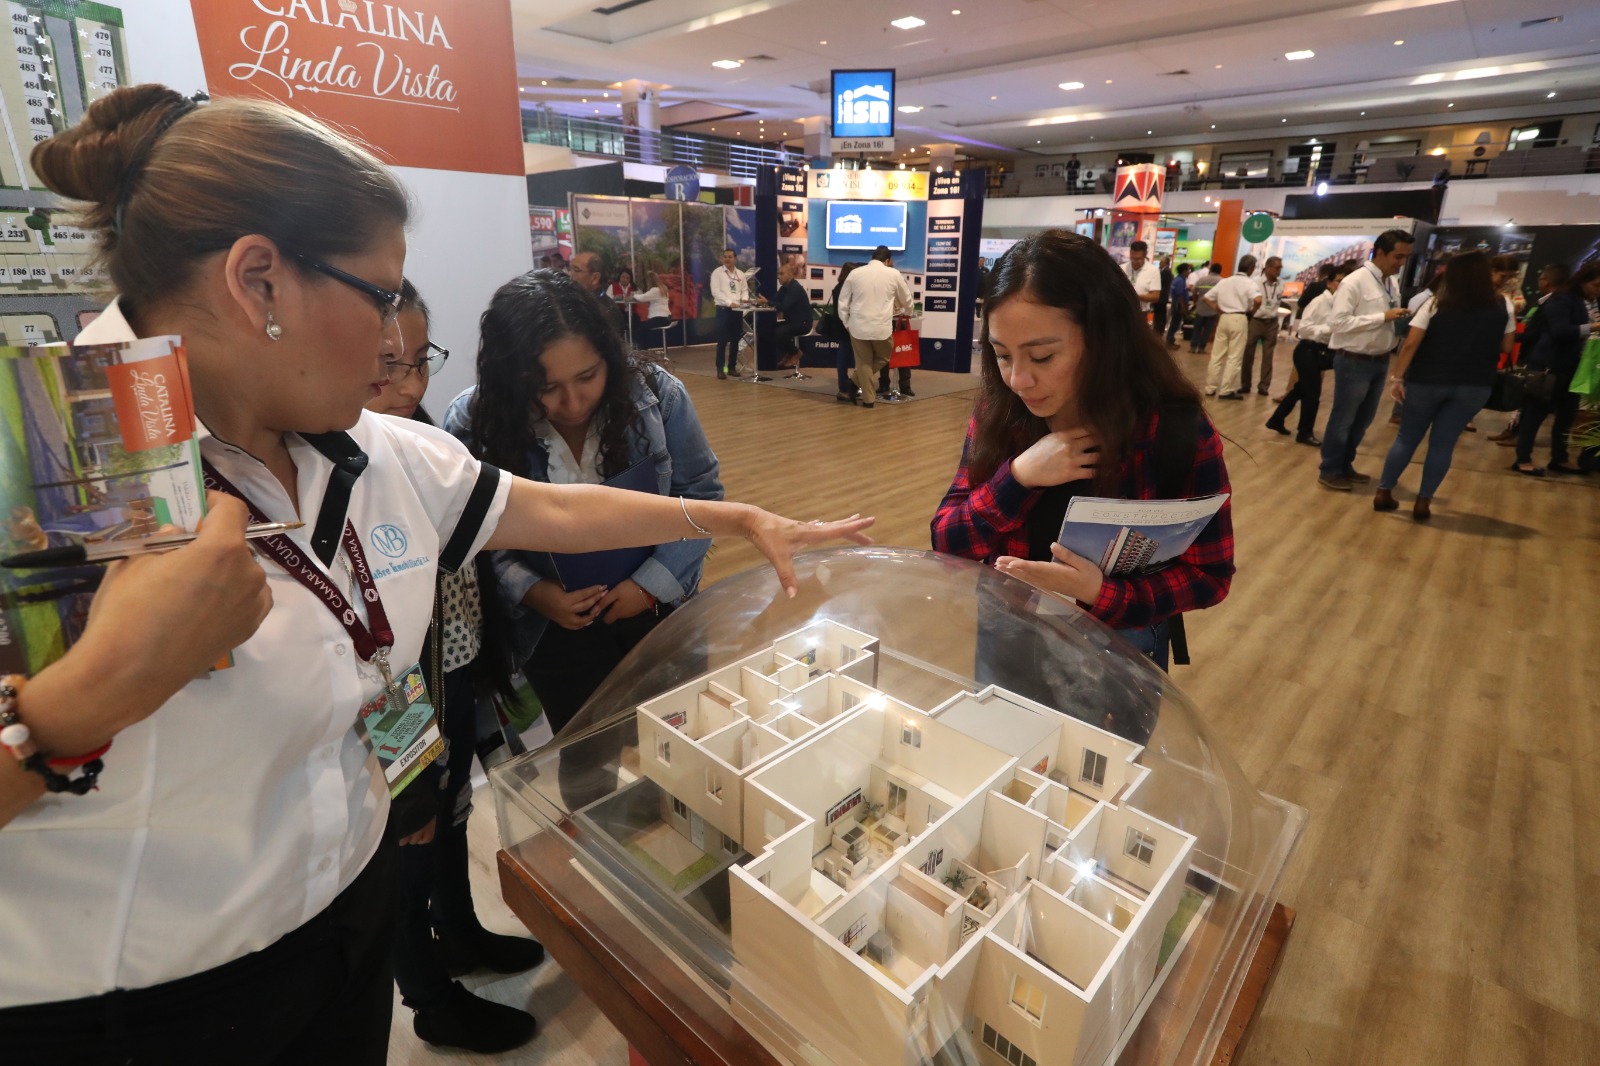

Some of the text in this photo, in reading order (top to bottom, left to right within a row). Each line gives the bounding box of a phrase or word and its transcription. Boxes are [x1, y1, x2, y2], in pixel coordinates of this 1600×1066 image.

[11, 13, 29, 23] 480
[12, 26, 28, 36] 481
[94, 31, 110, 41] 479
[16, 46, 33, 56] 482
[96, 48, 112, 58] 478
[228, 20, 457, 102] Linda Vista
[19, 62, 36, 73] 483
[98, 65, 113, 75] 477
[23, 80, 40, 90] 484
[26, 97, 43, 108] 485
[30, 116, 46, 126] 486
[852, 141, 870, 149] Zona
[872, 140, 884, 149] 16!
[933, 187, 949, 195] Zona
[62, 268, 74, 276] 184
[25, 325, 35, 333] 77
[815, 341, 829, 349] Final
[153, 374, 176, 438] CATALINA
[406, 682, 422, 698] EXPO
[400, 738, 427, 768] EXPOSITOR
